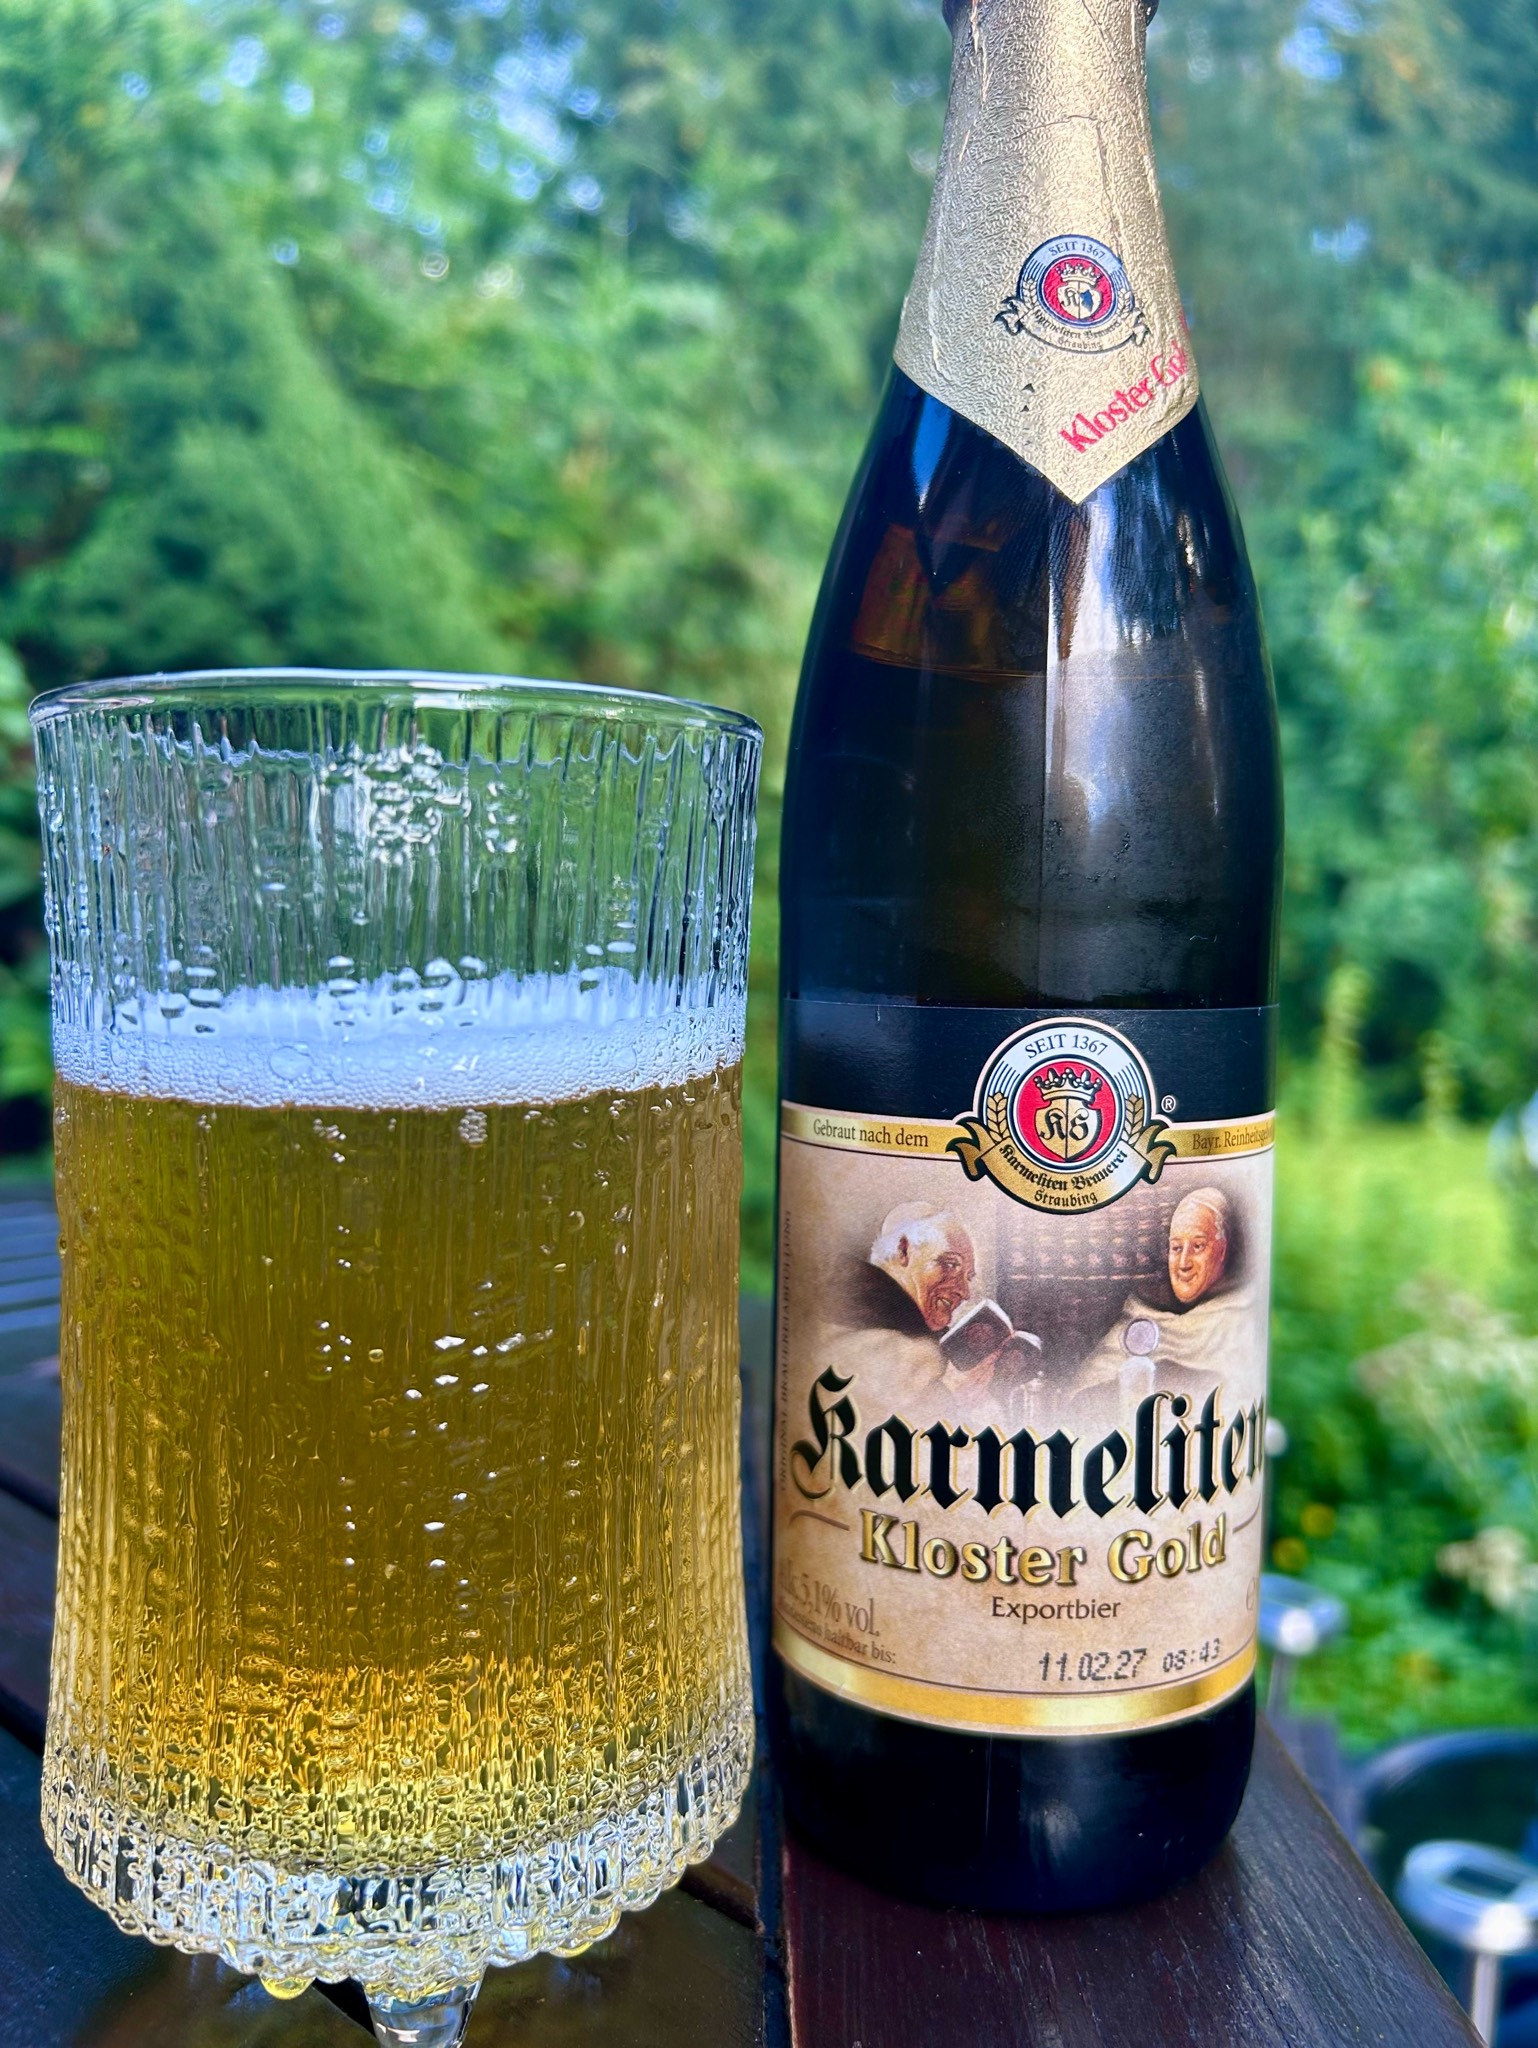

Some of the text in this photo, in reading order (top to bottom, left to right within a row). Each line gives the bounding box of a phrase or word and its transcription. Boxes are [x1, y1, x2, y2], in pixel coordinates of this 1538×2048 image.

[1049, 241, 1107, 260] SEIT 1367
[1058, 375, 1153, 454] Kloster
[1025, 1033, 1109, 1059] SEIT 1367
[813, 1118, 929, 1147] Gebraut nach dem
[1192, 1133, 1222, 1155] Bayr.
[999, 1143, 1128, 1192] Karmeliten Brauerei
[1033, 1189, 1098, 1207] Straubing
[791, 1364, 1265, 1518] Karmeliten
[859, 1506, 1228, 1585] Kloster Gold
[798, 1572, 842, 1622] 5,1%
[844, 1597, 881, 1637] vol.
[991, 1596, 1121, 1624] Exportbier
[871, 1642, 897, 1665] bis:
[1038, 1638, 1221, 1682] 11.02.27 08:43
